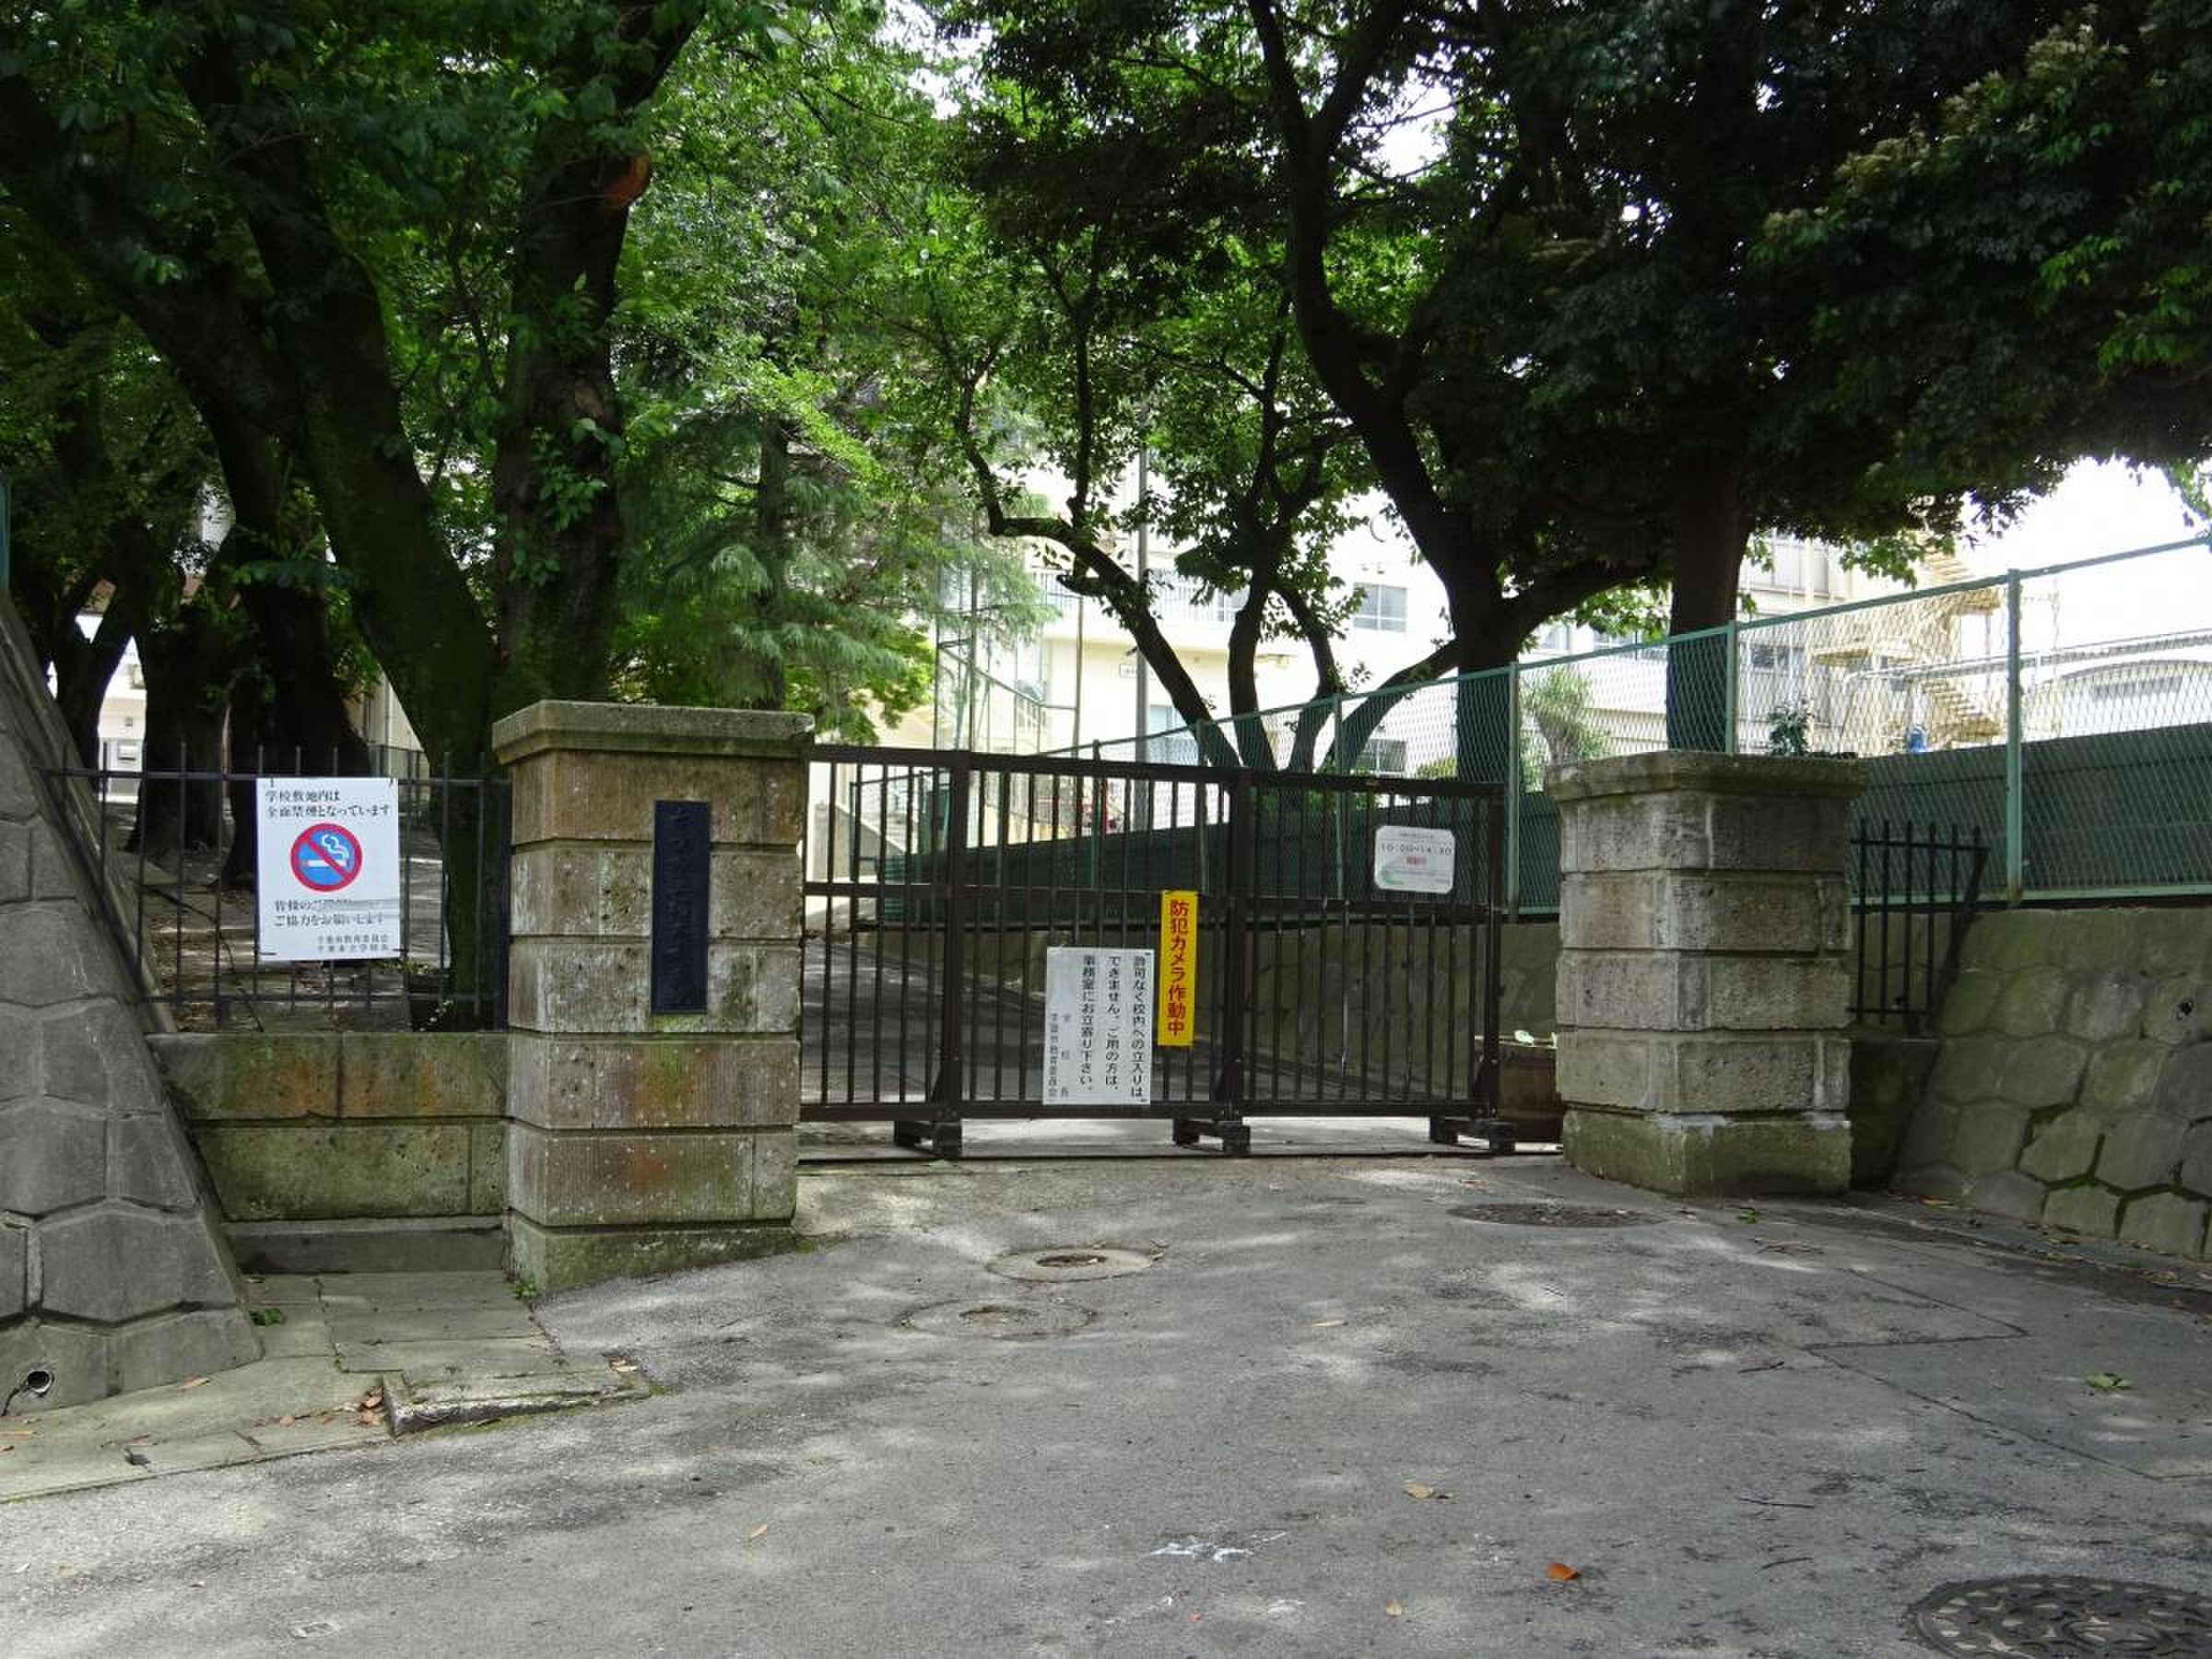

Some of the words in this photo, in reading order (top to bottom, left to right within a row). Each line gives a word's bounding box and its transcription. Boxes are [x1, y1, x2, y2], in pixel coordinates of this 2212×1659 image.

[1131, 956, 1147, 1098] 許可なく校内への立入りは
[1166, 900, 1190, 1037] 防犯カメラ作動中
